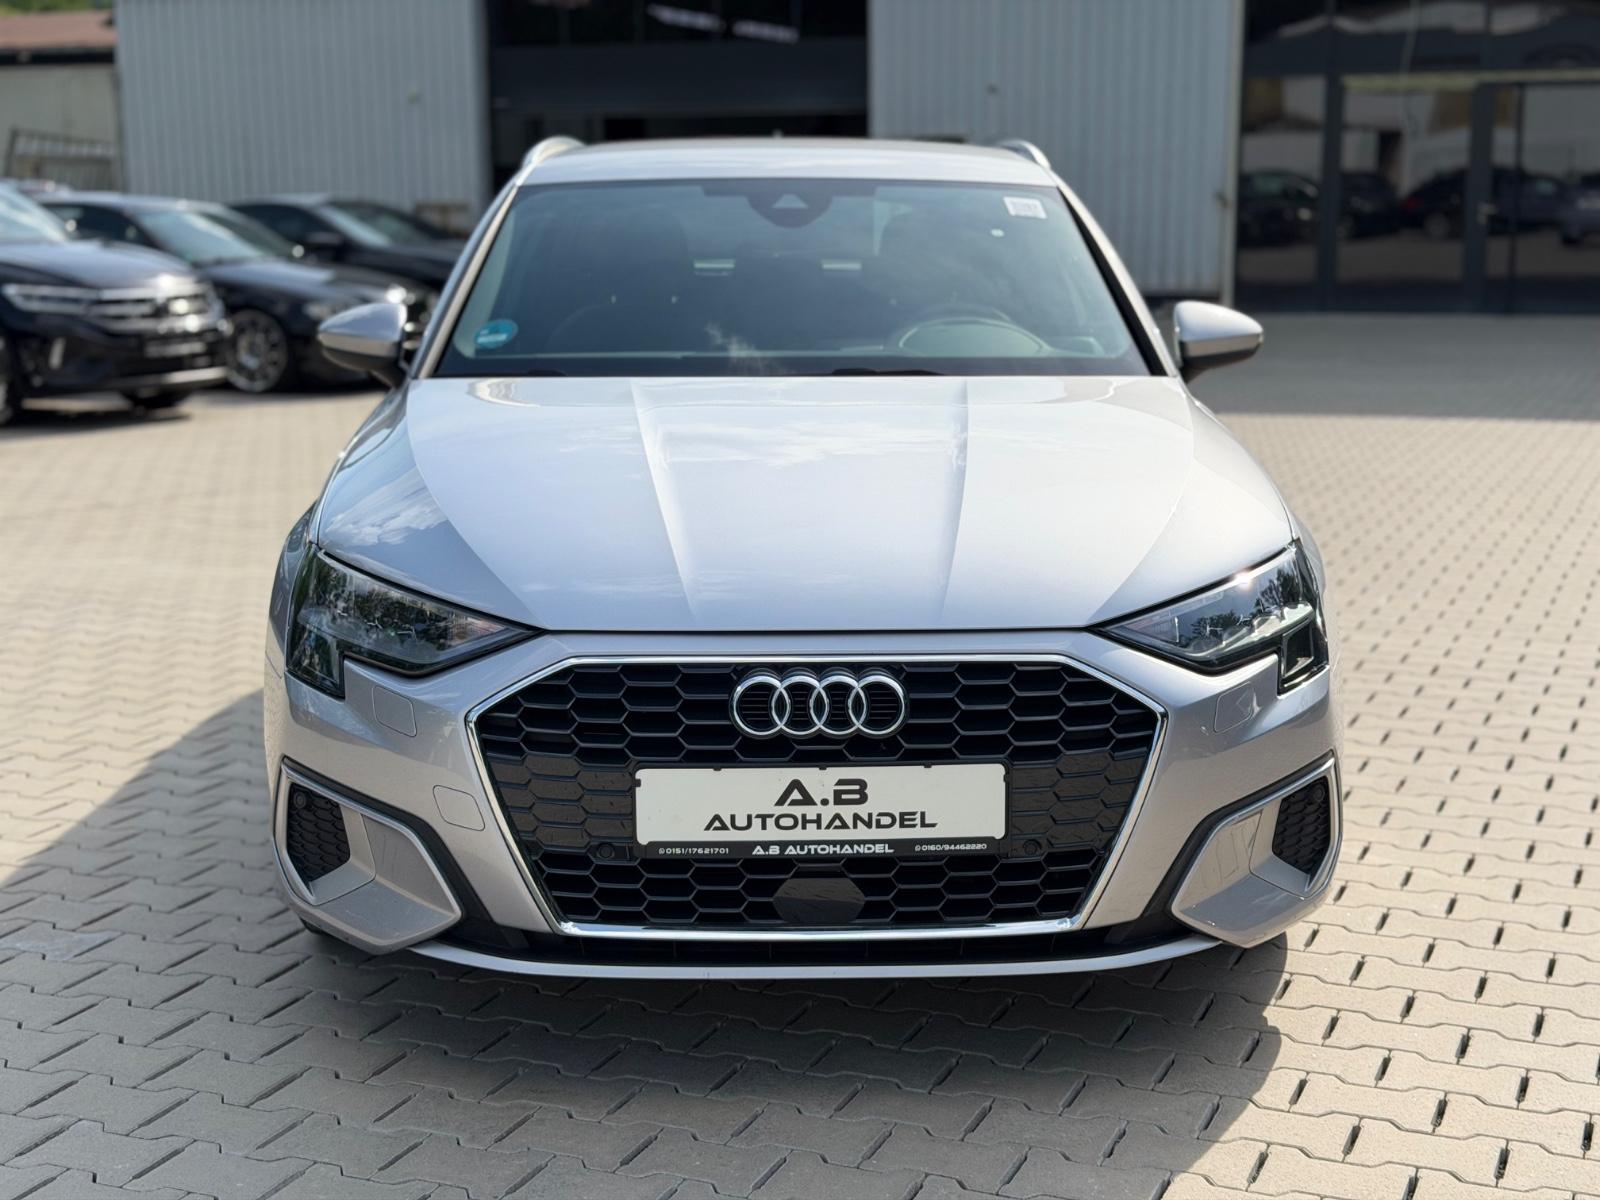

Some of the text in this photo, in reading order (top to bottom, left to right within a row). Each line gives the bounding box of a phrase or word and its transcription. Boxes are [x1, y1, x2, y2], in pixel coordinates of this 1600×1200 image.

[774, 778, 869, 807] A.B
[703, 811, 938, 831] AUTOHANDEL
[751, 843, 895, 855] A.B AUTOHANDEL
